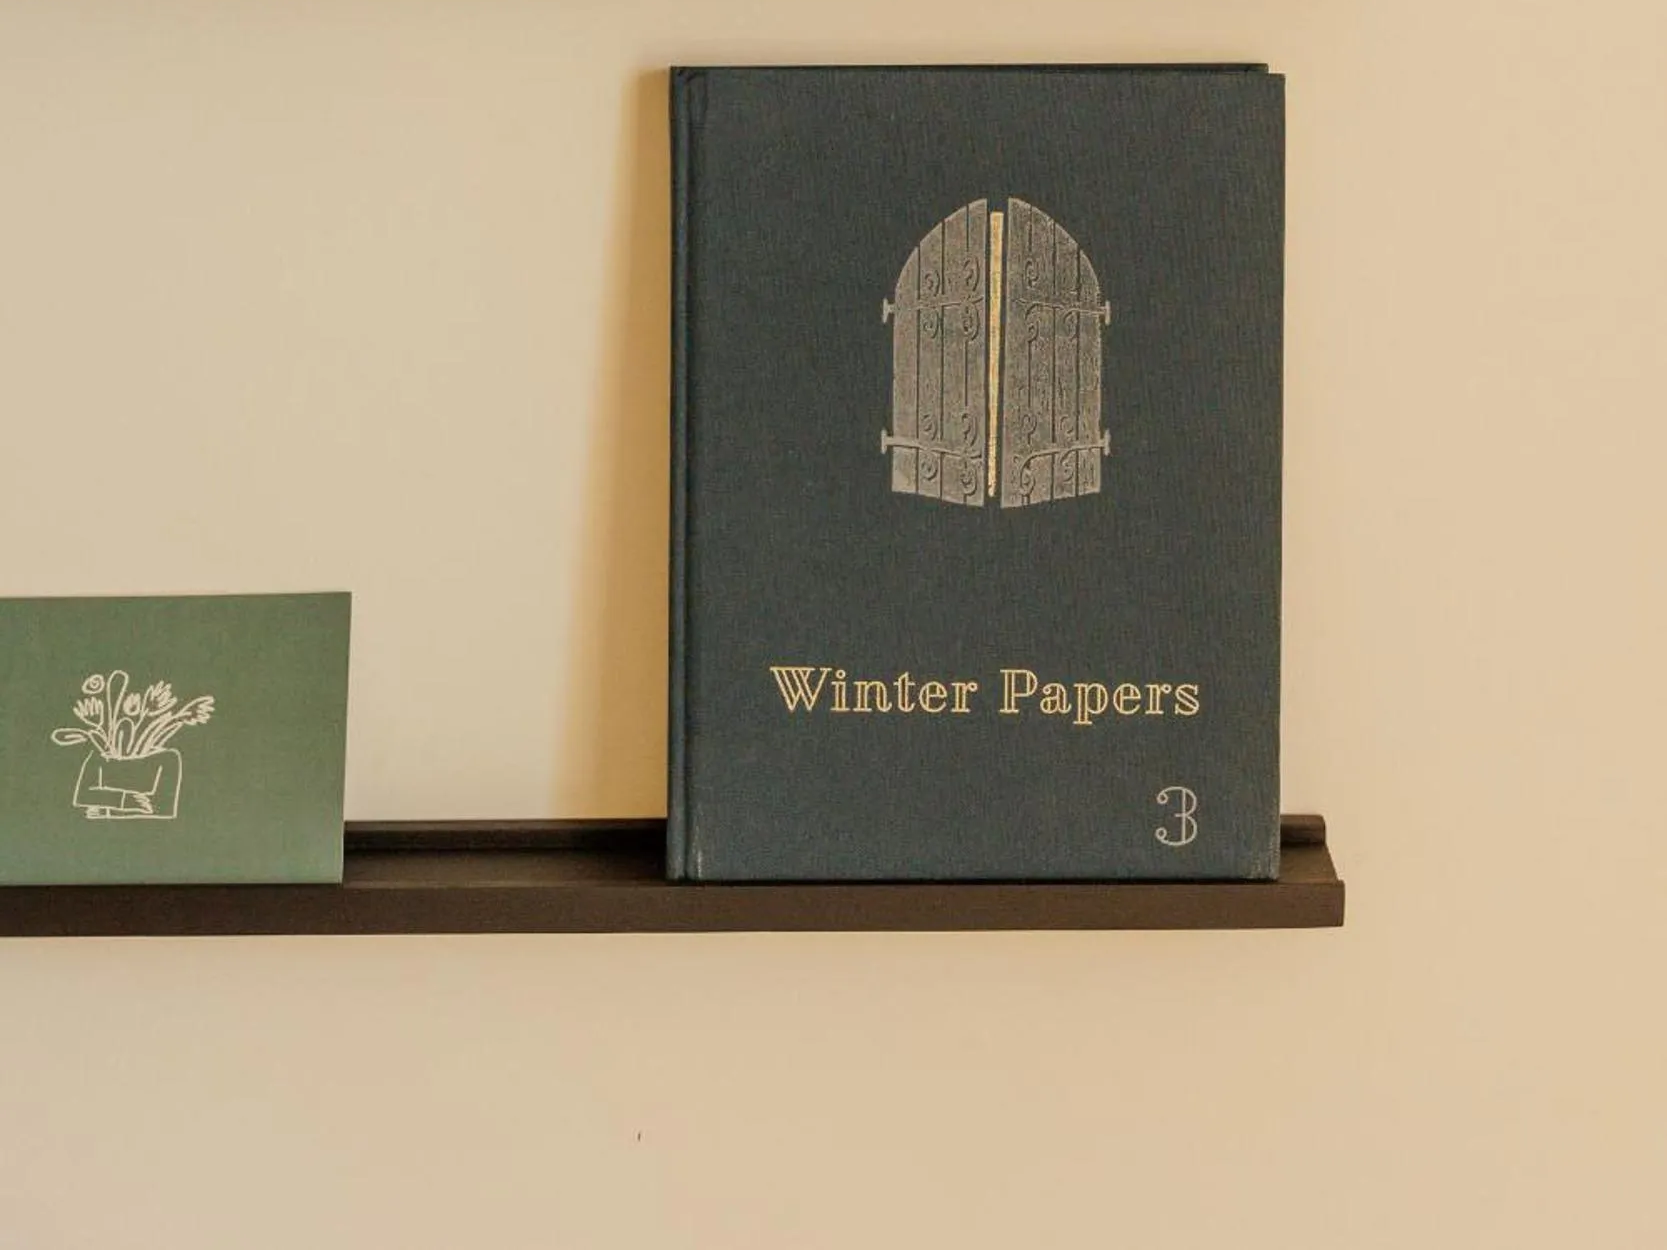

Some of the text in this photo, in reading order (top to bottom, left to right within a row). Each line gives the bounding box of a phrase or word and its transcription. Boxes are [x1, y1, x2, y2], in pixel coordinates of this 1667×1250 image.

[770, 666, 1200, 725] Winter Papers
[1154, 785, 1198, 847] 3
